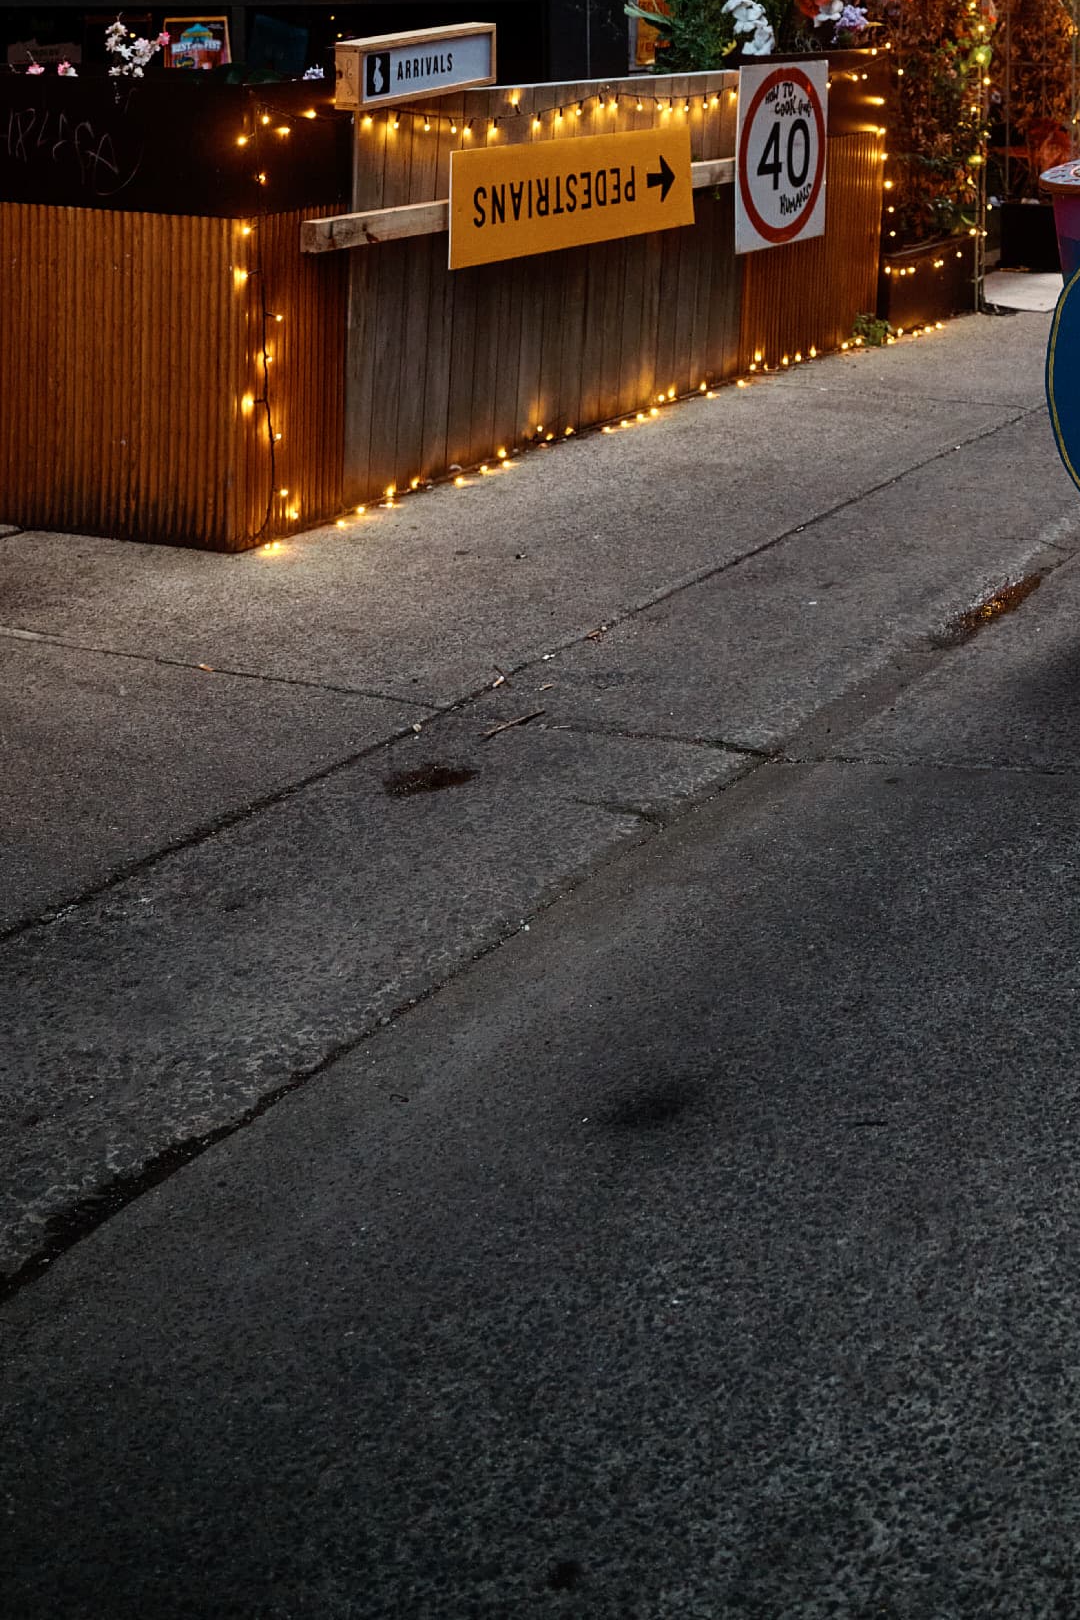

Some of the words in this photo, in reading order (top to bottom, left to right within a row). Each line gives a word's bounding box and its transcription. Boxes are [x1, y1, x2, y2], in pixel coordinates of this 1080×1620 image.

[397, 52, 453, 80] ARRIVALS
[782, 82, 794, 99] TO
[757, 118, 810, 190] 40
[473, 165, 636, 228] PEDESTRIANS
[780, 183, 812, 216] HUMANS
